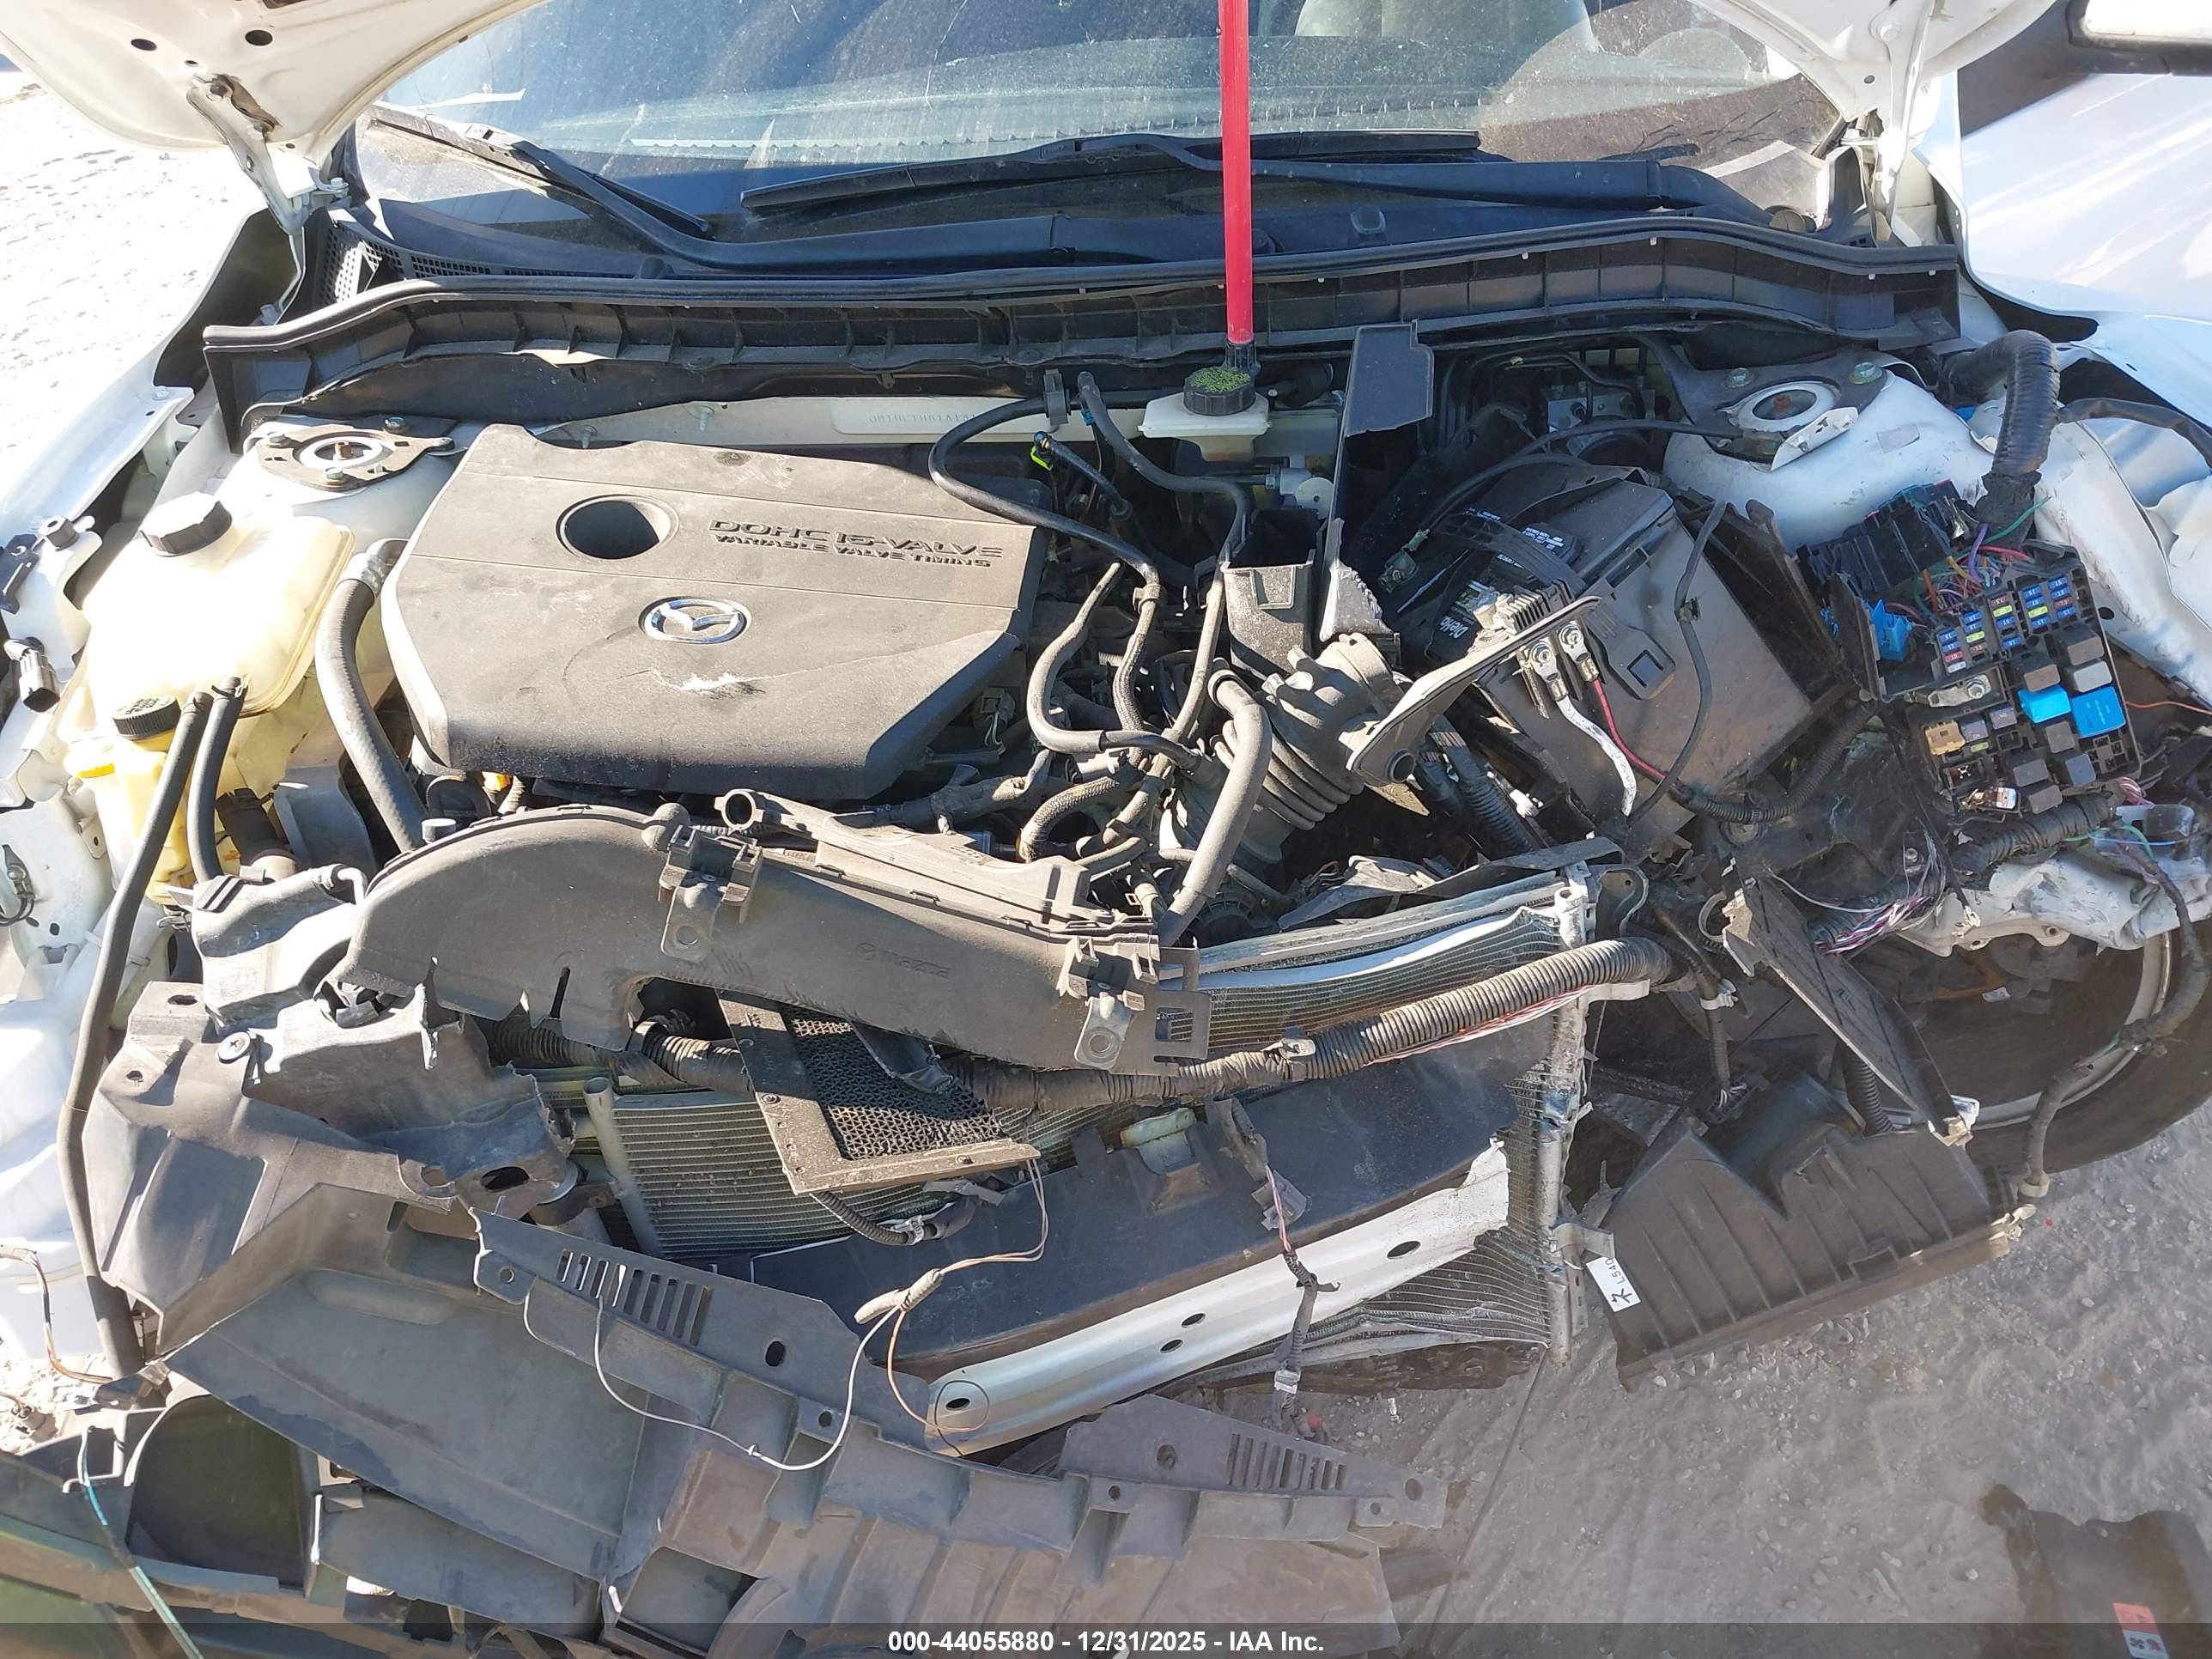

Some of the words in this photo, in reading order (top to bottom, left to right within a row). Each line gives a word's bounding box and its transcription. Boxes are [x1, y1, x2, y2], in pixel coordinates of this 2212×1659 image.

[708, 520, 830, 542] DOHC
[836, 532, 1003, 558] 16-VALVE
[714, 534, 830, 552] VARIABLE
[833, 545, 906, 562] VALVE
[909, 553, 992, 568] TIMING
